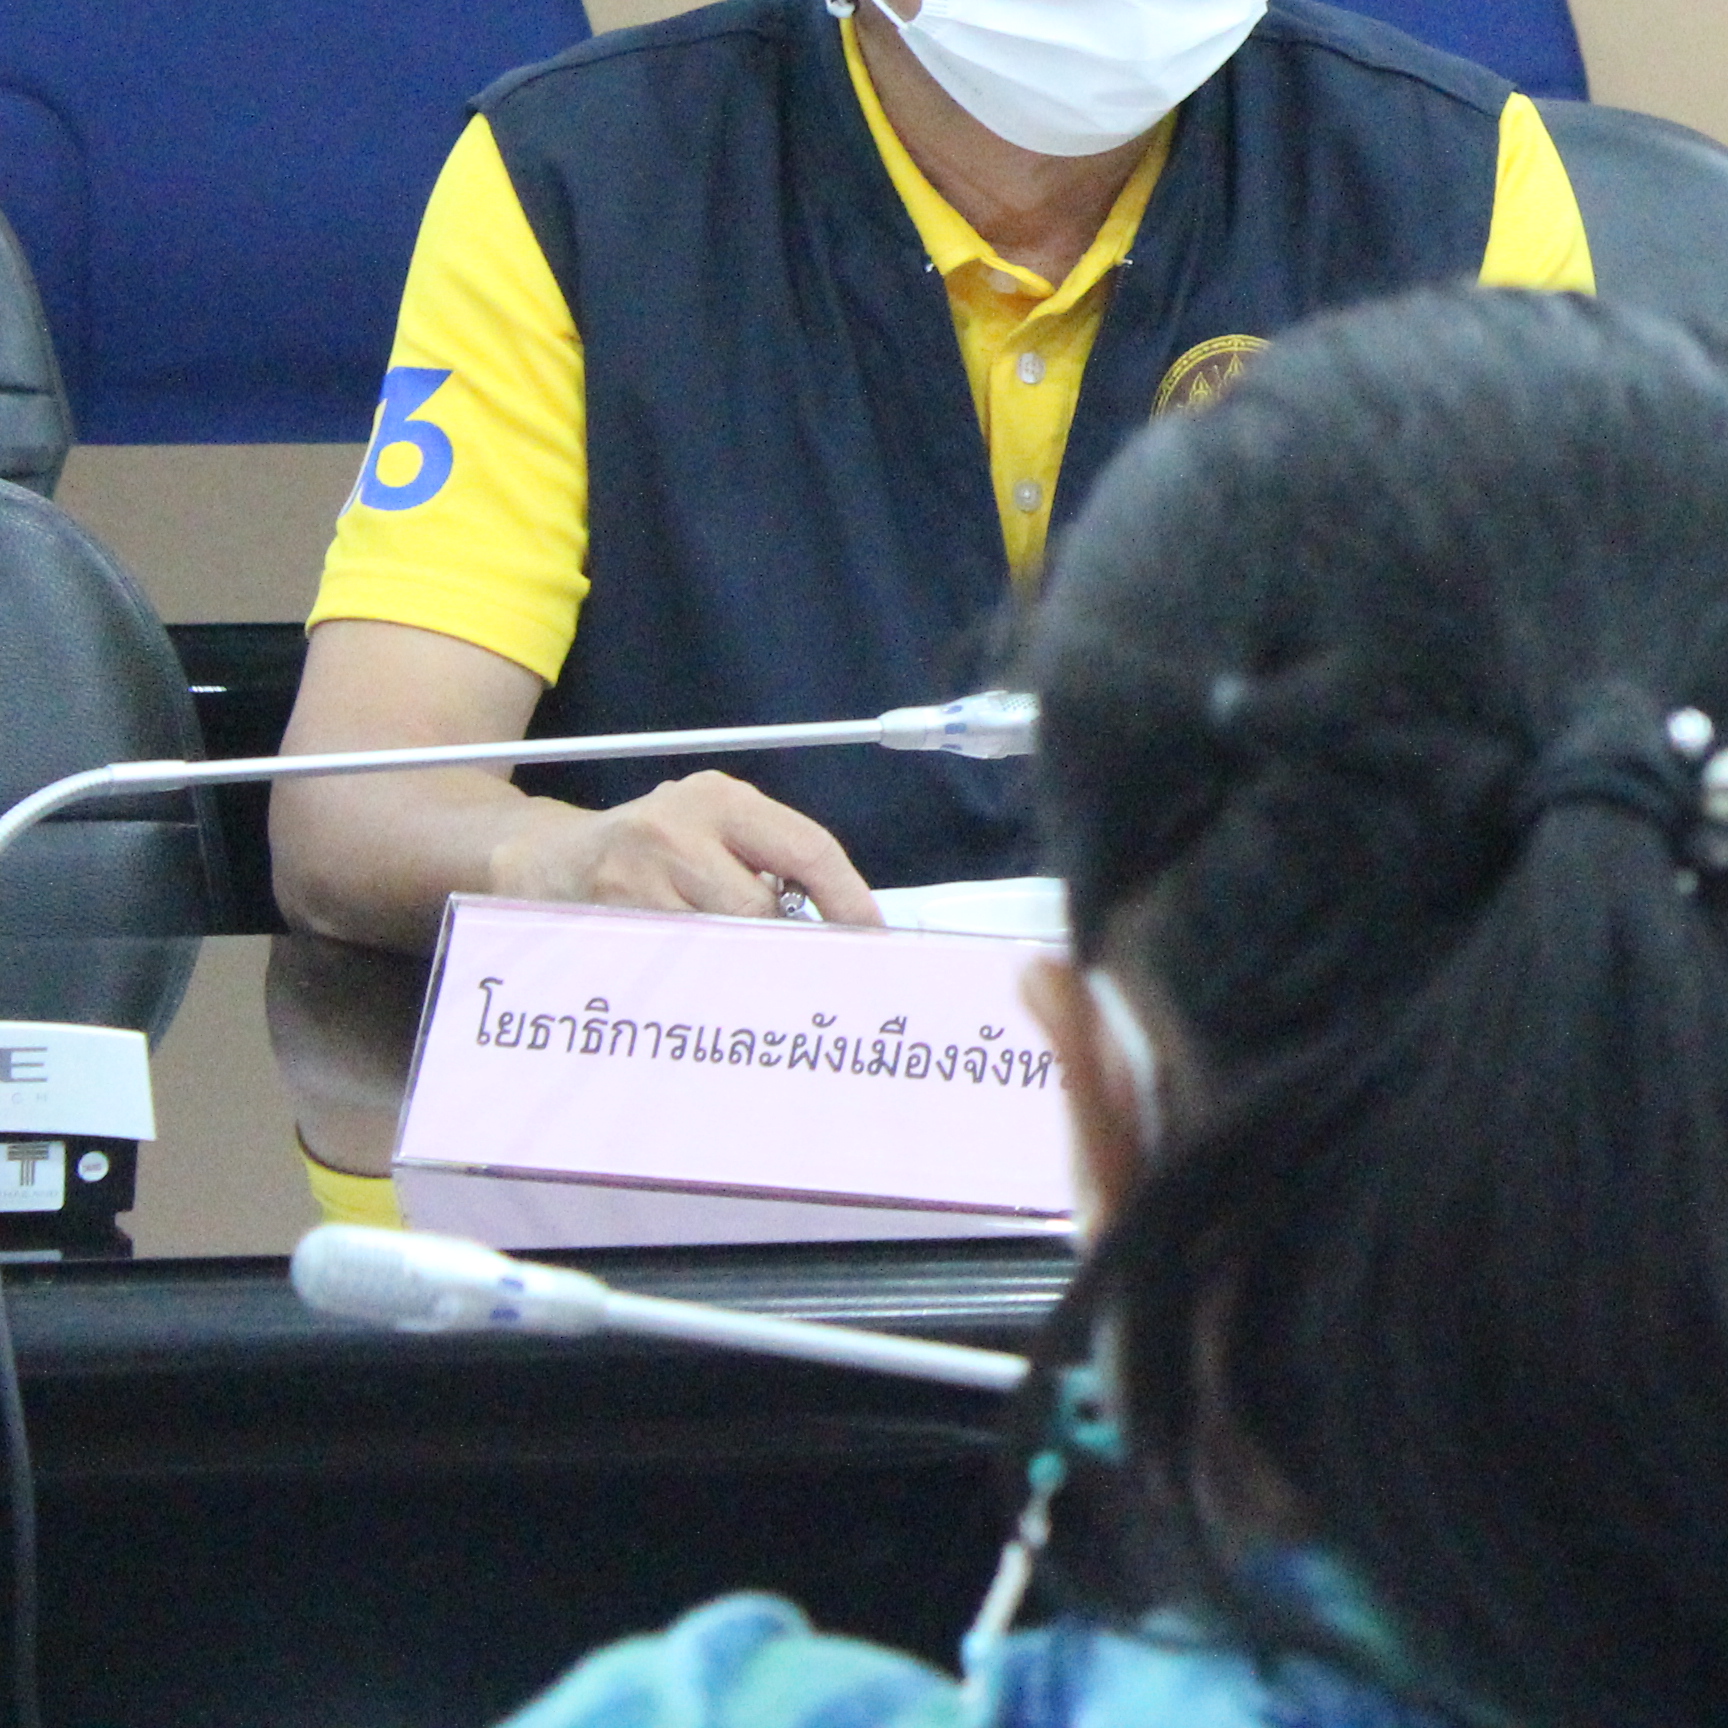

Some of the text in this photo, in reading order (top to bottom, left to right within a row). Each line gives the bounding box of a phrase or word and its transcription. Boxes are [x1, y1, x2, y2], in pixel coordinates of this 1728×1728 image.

[474, 976, 1064, 1090] โยธาธิการและผังเมืองจังห
